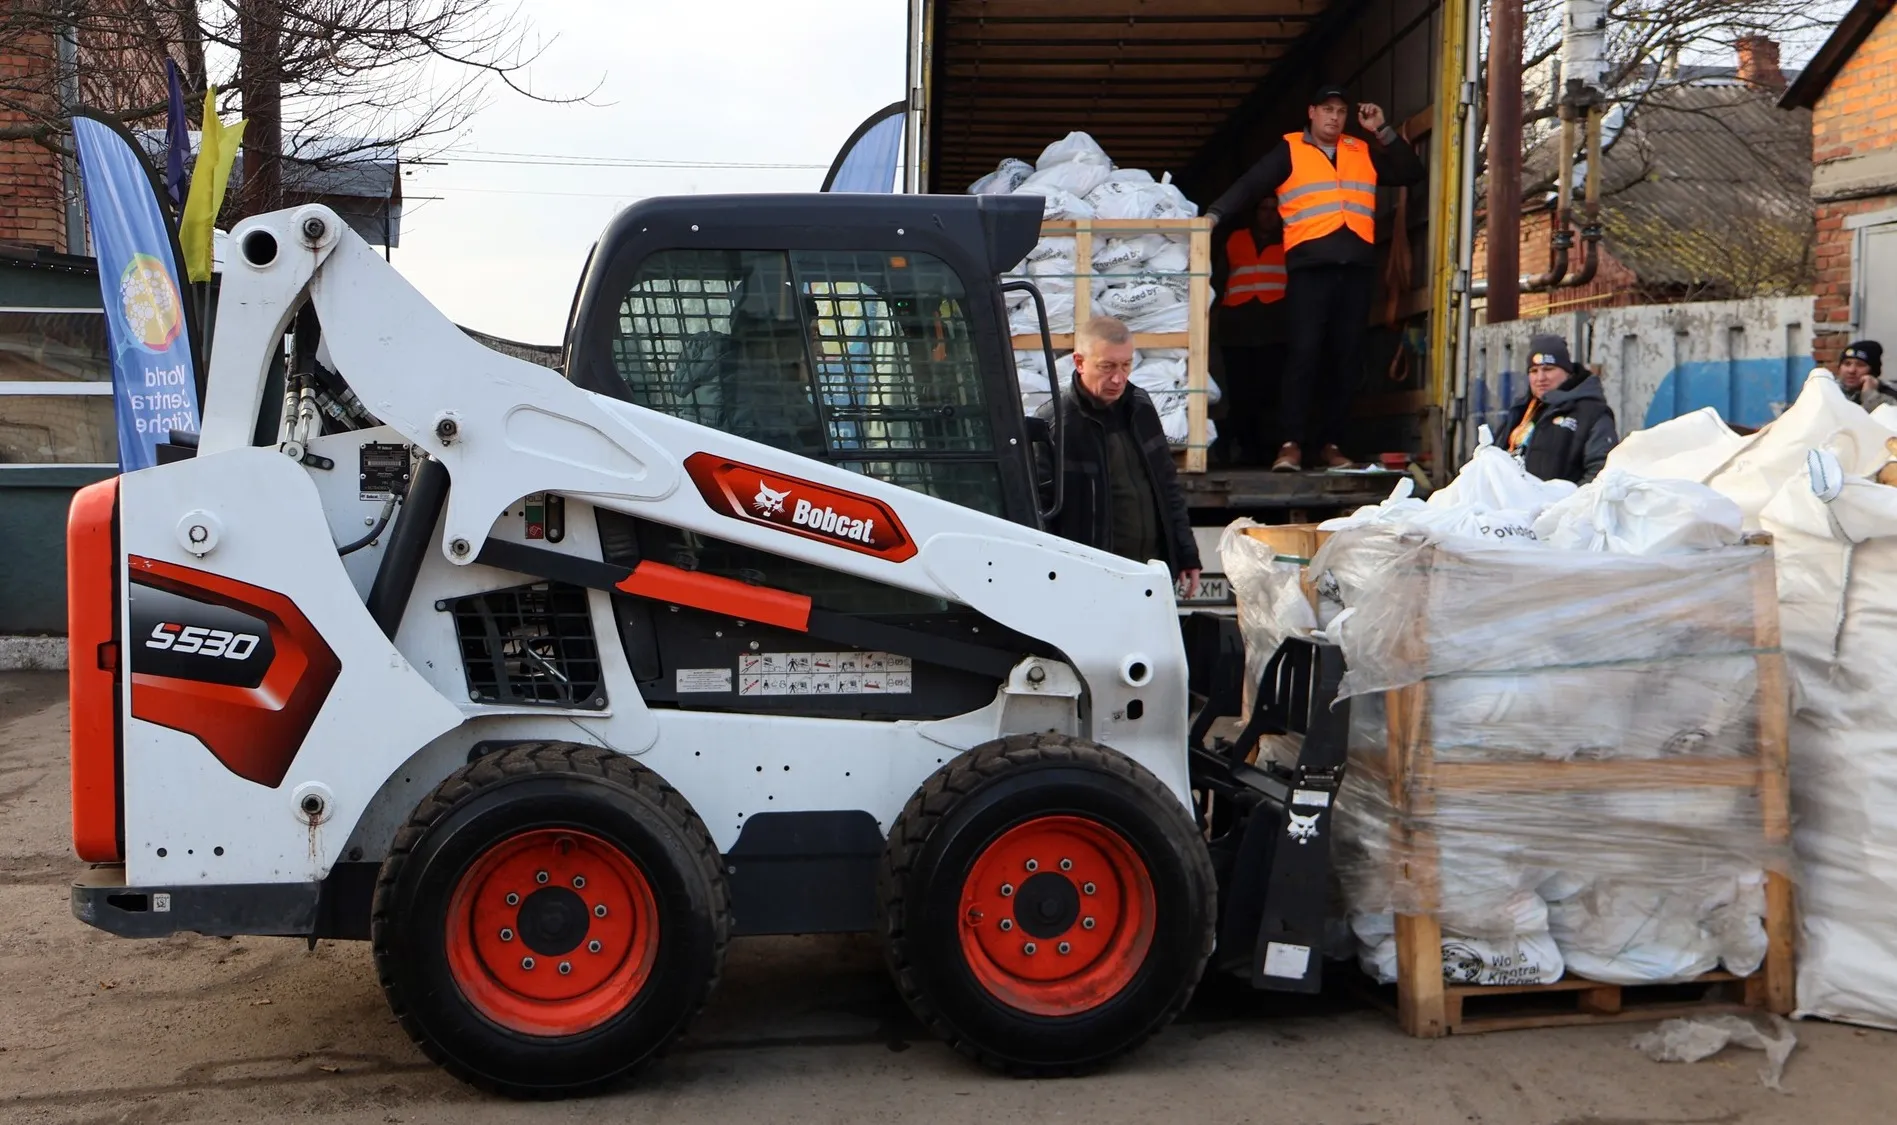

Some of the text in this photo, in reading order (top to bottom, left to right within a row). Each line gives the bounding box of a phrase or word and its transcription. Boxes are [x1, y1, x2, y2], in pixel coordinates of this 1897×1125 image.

[792, 498, 874, 544] Bobcat
[145, 622, 260, 660] S530
[1492, 954, 1527, 967] Wod
[1496, 963, 1540, 977] ntral
